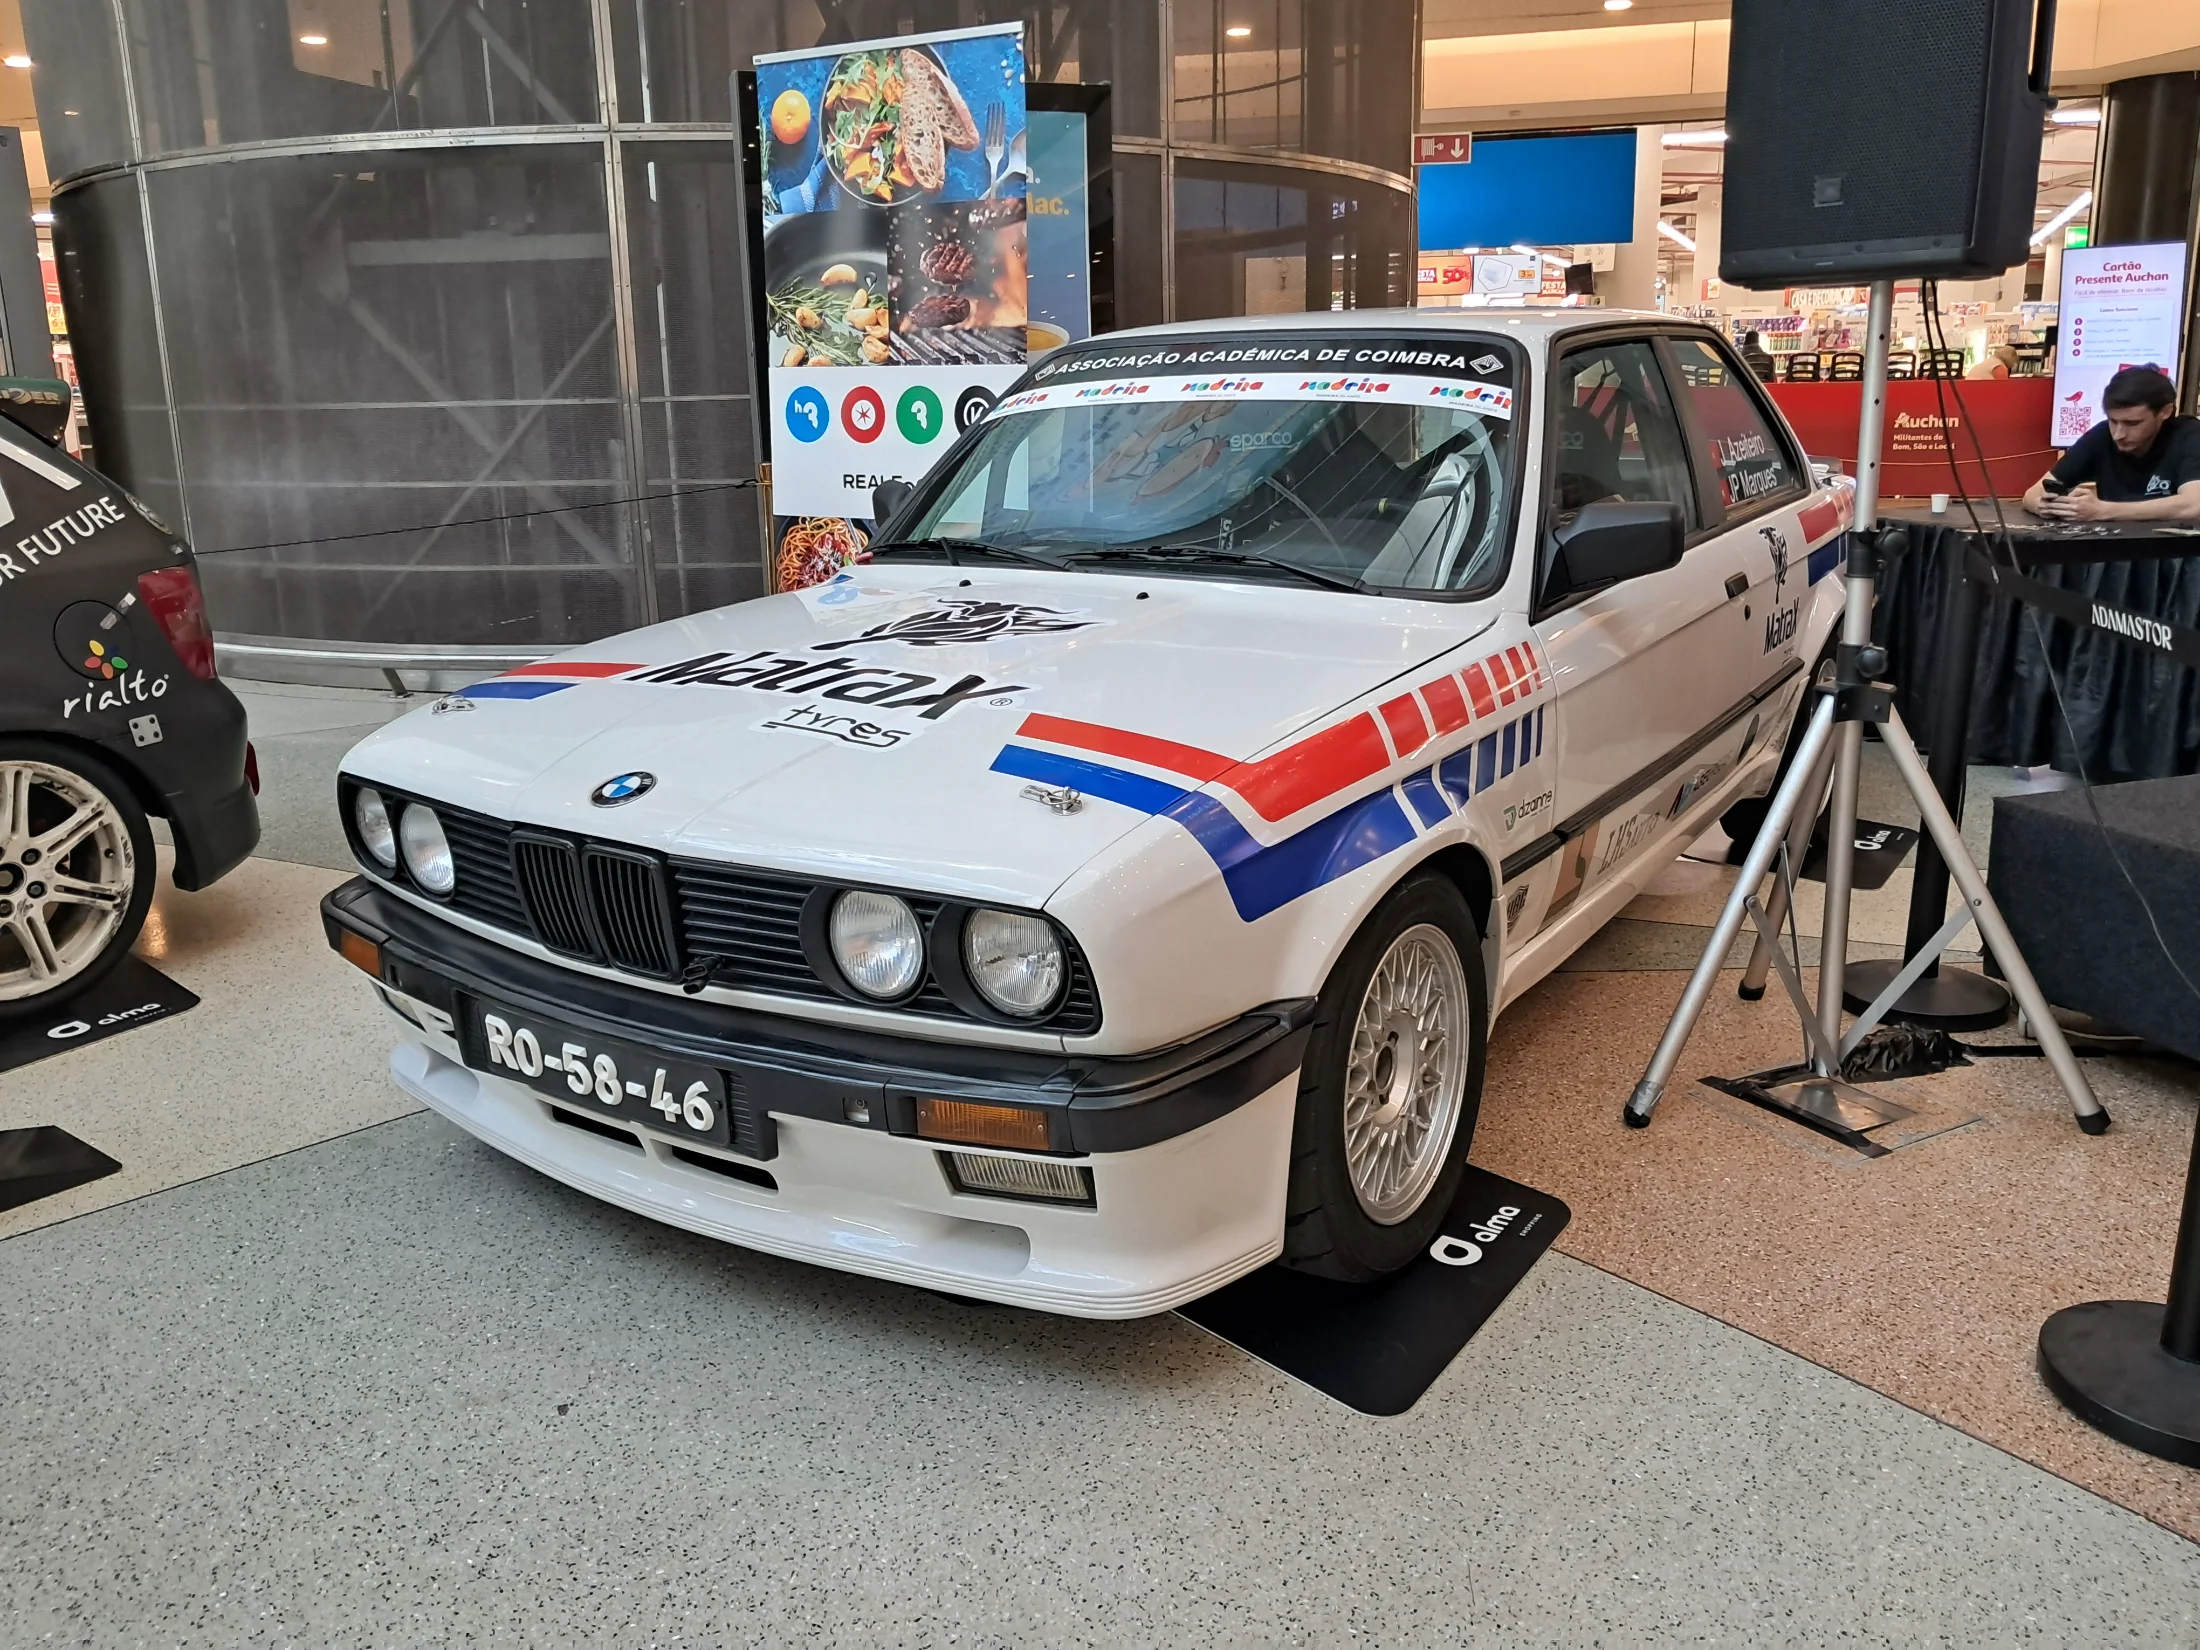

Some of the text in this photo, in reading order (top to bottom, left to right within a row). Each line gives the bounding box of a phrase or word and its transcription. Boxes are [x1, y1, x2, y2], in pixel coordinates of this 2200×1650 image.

[2075, 271, 2169, 285] Presente Auchan
[2102, 261, 2142, 272] Cartão
[1054, 346, 1466, 376] ASSOCIAÇÃO ACADÉMICA DE COIMBRA
[1230, 431, 1292, 450] sparco
[1892, 443, 1912, 451] Bom,
[1934, 442, 1956, 450] Locl
[1893, 433, 1944, 441] Militantes do
[1739, 467, 1779, 498] Marques
[16, 496, 126, 565] FUTURE
[2091, 604, 2173, 651] ADAMASTOR
[63, 669, 167, 719] rialto
[775, 704, 911, 747] tyres
[98, 1003, 161, 1025] alma
[485, 1013, 715, 1132] RO-58-46
[1468, 1205, 1522, 1243] alma
